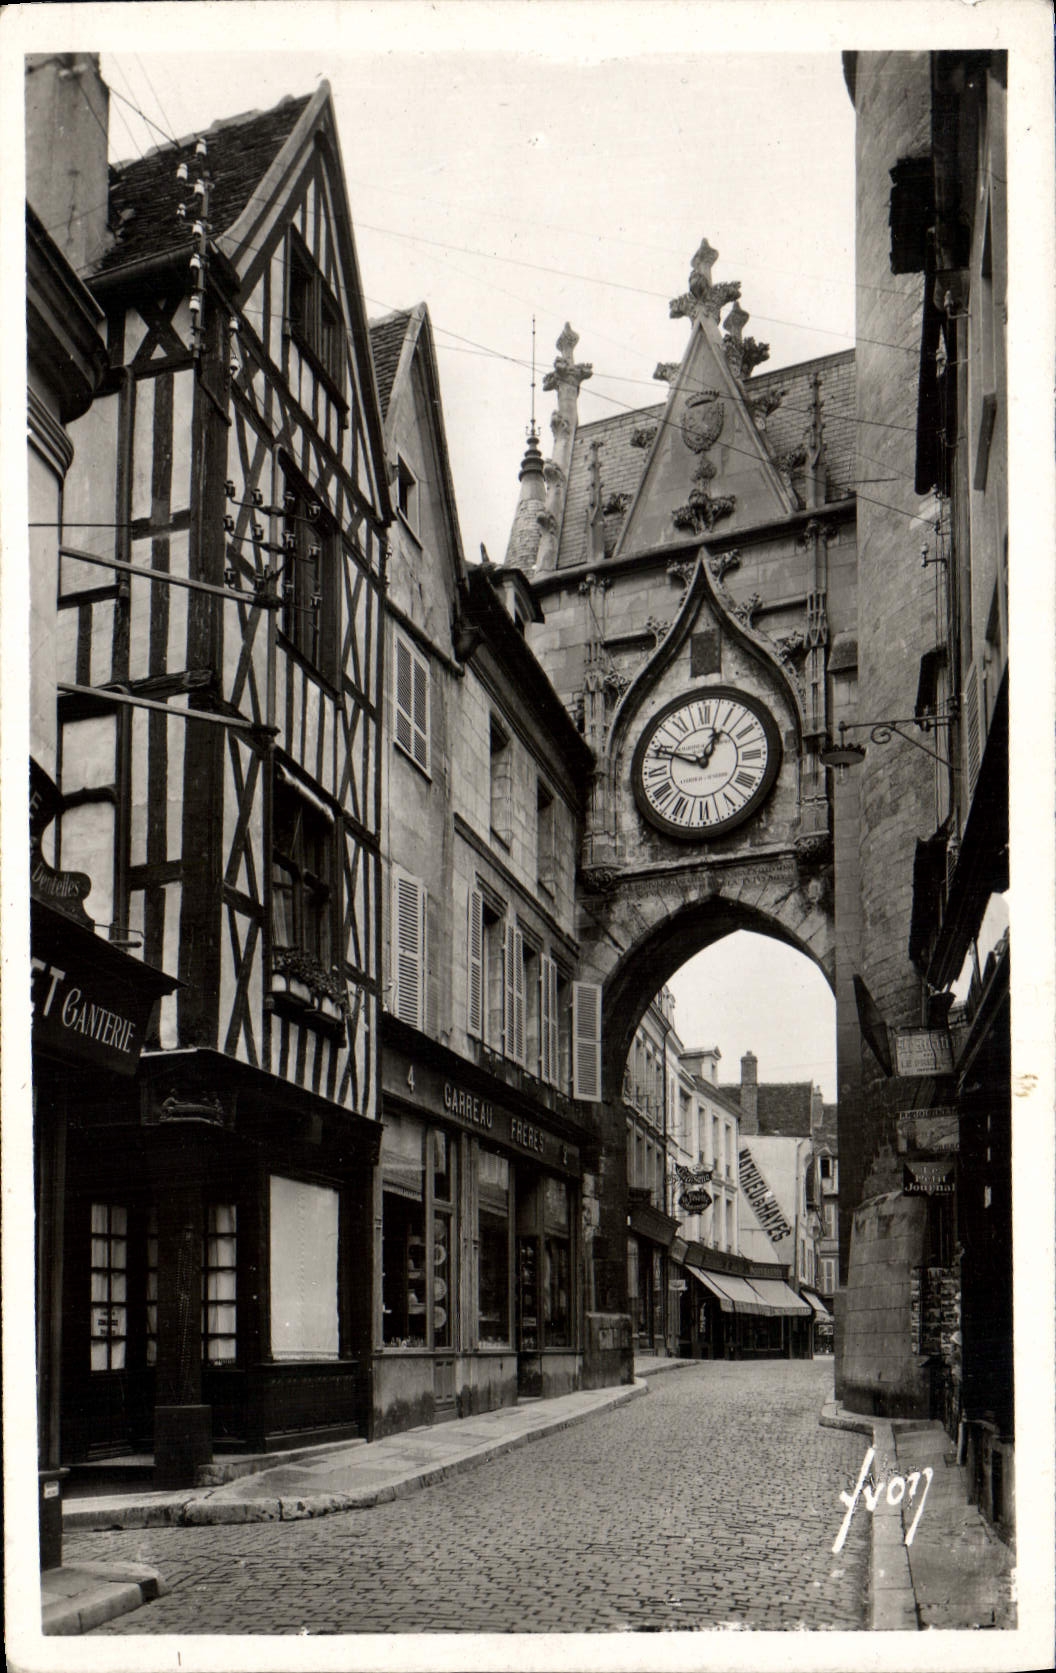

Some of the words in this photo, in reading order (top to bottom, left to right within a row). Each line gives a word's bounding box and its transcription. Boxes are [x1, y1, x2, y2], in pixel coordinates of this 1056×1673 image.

[32, 862, 80, 897] Dentelles
[62, 988, 136, 1053] GANTERIE
[407, 1065, 416, 1093] 4
[444, 1082, 493, 1129] GARREAU
[739, 1148, 768, 1200] MATHIEU
